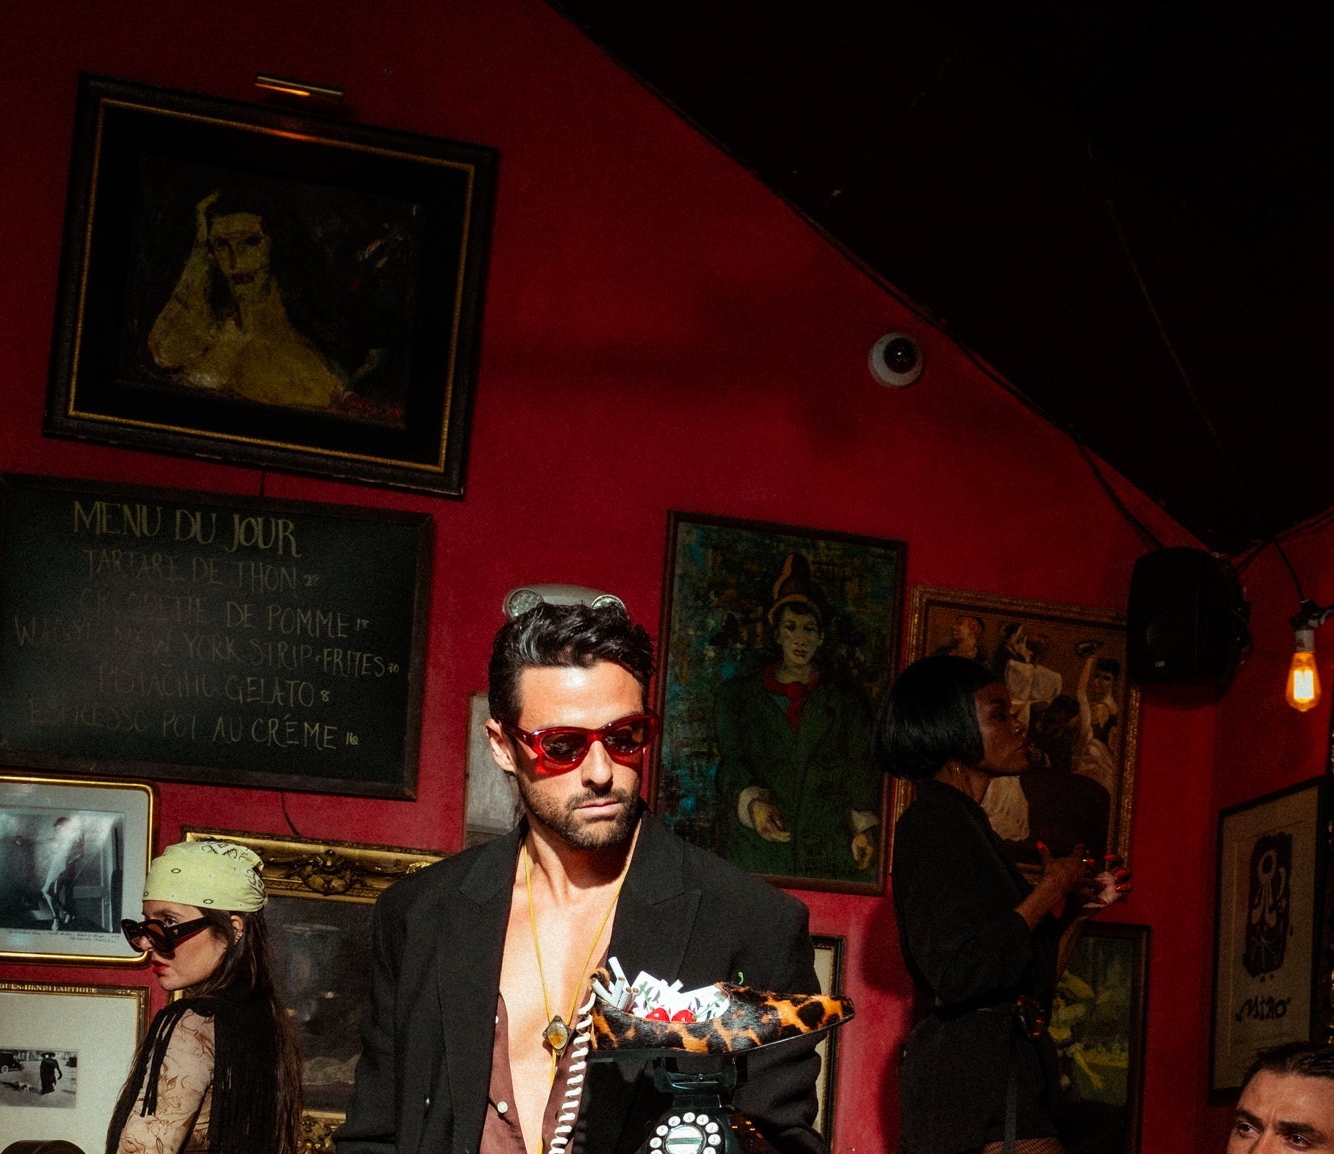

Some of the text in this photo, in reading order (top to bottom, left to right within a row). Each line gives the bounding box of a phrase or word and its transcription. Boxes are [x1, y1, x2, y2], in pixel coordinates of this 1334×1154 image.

[72, 500, 303, 559] MENU DU JOUR
[191, 556, 224, 586] DE
[237, 560, 299, 597] THON
[226, 600, 257, 629] DE
[267, 603, 350, 640] POMME
[182, 631, 245, 664] YORK
[225, 675, 316, 708] GELATO
[162, 708, 197, 740] POT
[212, 715, 244, 746] AU
